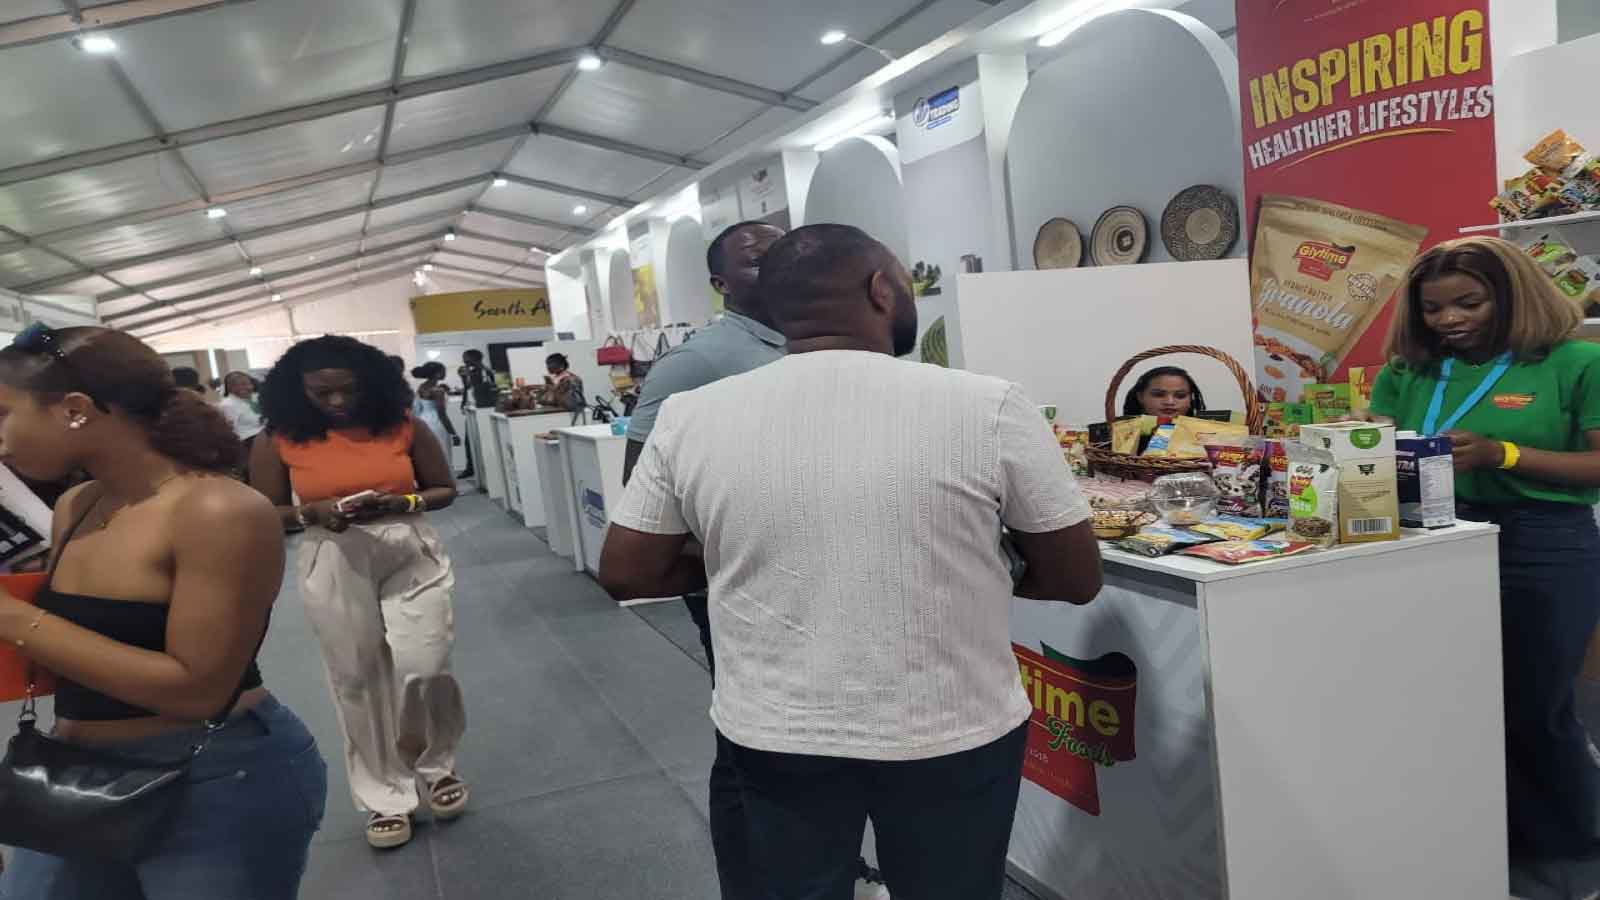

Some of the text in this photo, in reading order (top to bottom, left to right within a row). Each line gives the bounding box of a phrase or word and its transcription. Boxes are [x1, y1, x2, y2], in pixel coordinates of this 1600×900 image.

[1250, 9, 1484, 128] INSPIRING
[1249, 85, 1493, 169] HEALTHIER LIFESTYLES
[474, 300, 525, 319] South
